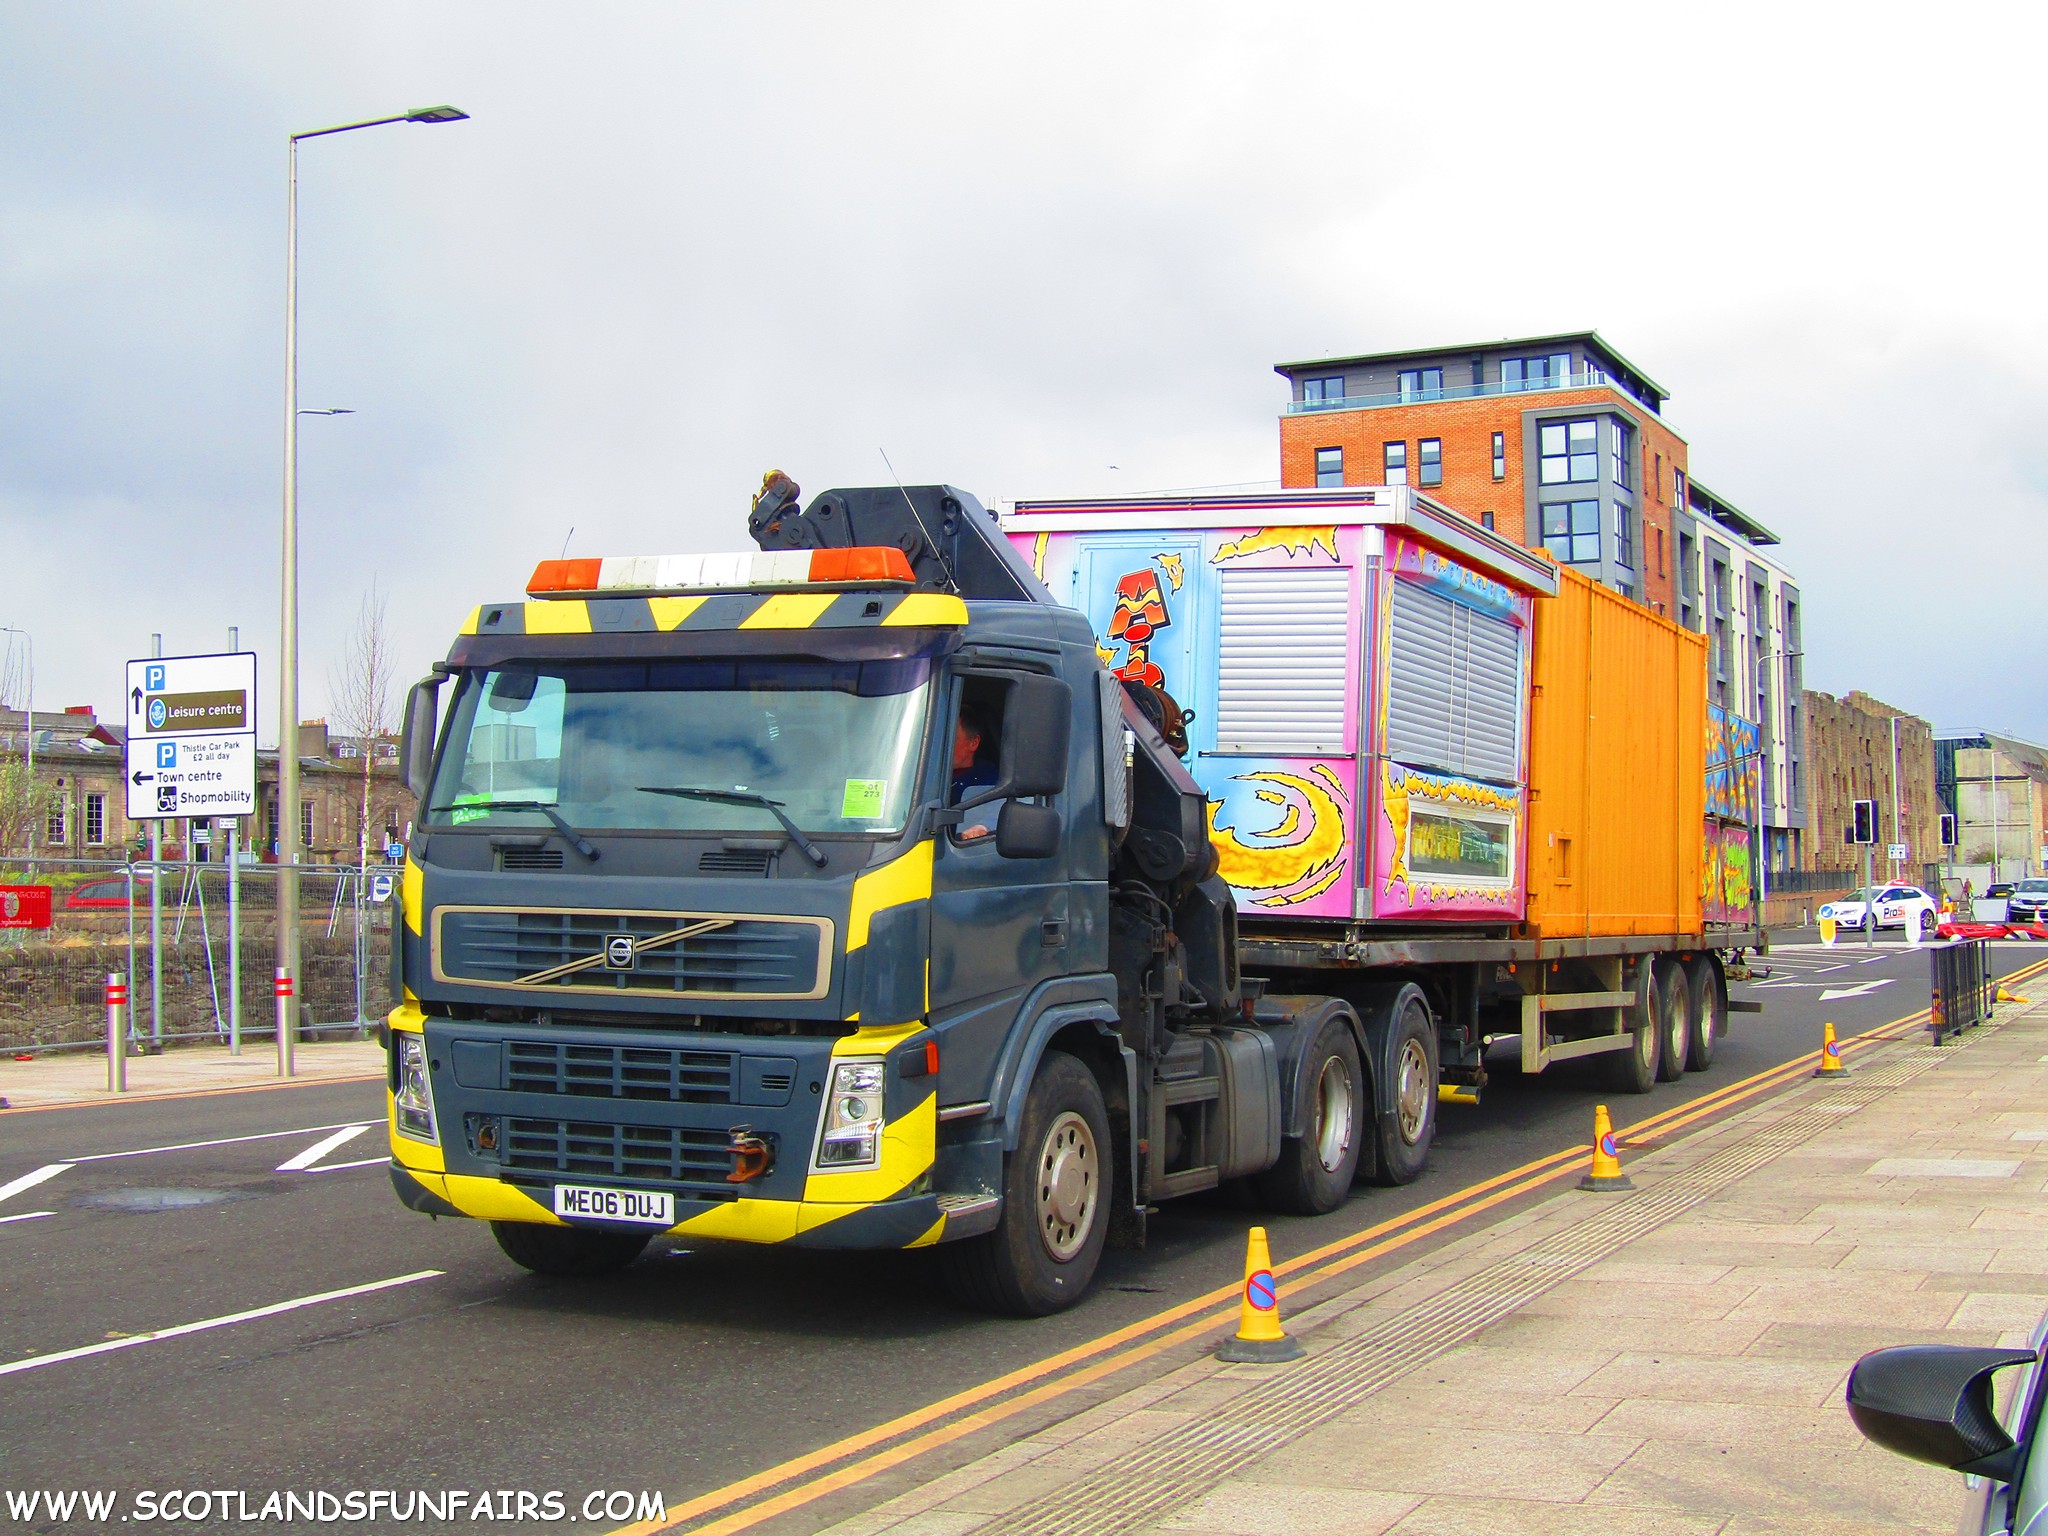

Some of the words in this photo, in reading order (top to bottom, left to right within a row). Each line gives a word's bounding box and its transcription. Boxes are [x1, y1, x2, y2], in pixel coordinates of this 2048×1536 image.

[150, 668, 163, 689] P
[168, 705, 205, 718] Leisure
[208, 703, 243, 716] centre
[182, 743, 207, 753] Thistle
[208, 743, 222, 751] Car
[224, 741, 240, 750] Park
[161, 745, 174, 766] P
[193, 753, 203, 762] £2
[205, 753, 215, 761] all
[217, 752, 230, 761] day
[157, 771, 184, 783] Town
[187, 770, 222, 781] centre
[180, 790, 251, 806] Shopmobility
[563, 1189, 618, 1215] ME06
[624, 1193, 665, 1219] DUJ
